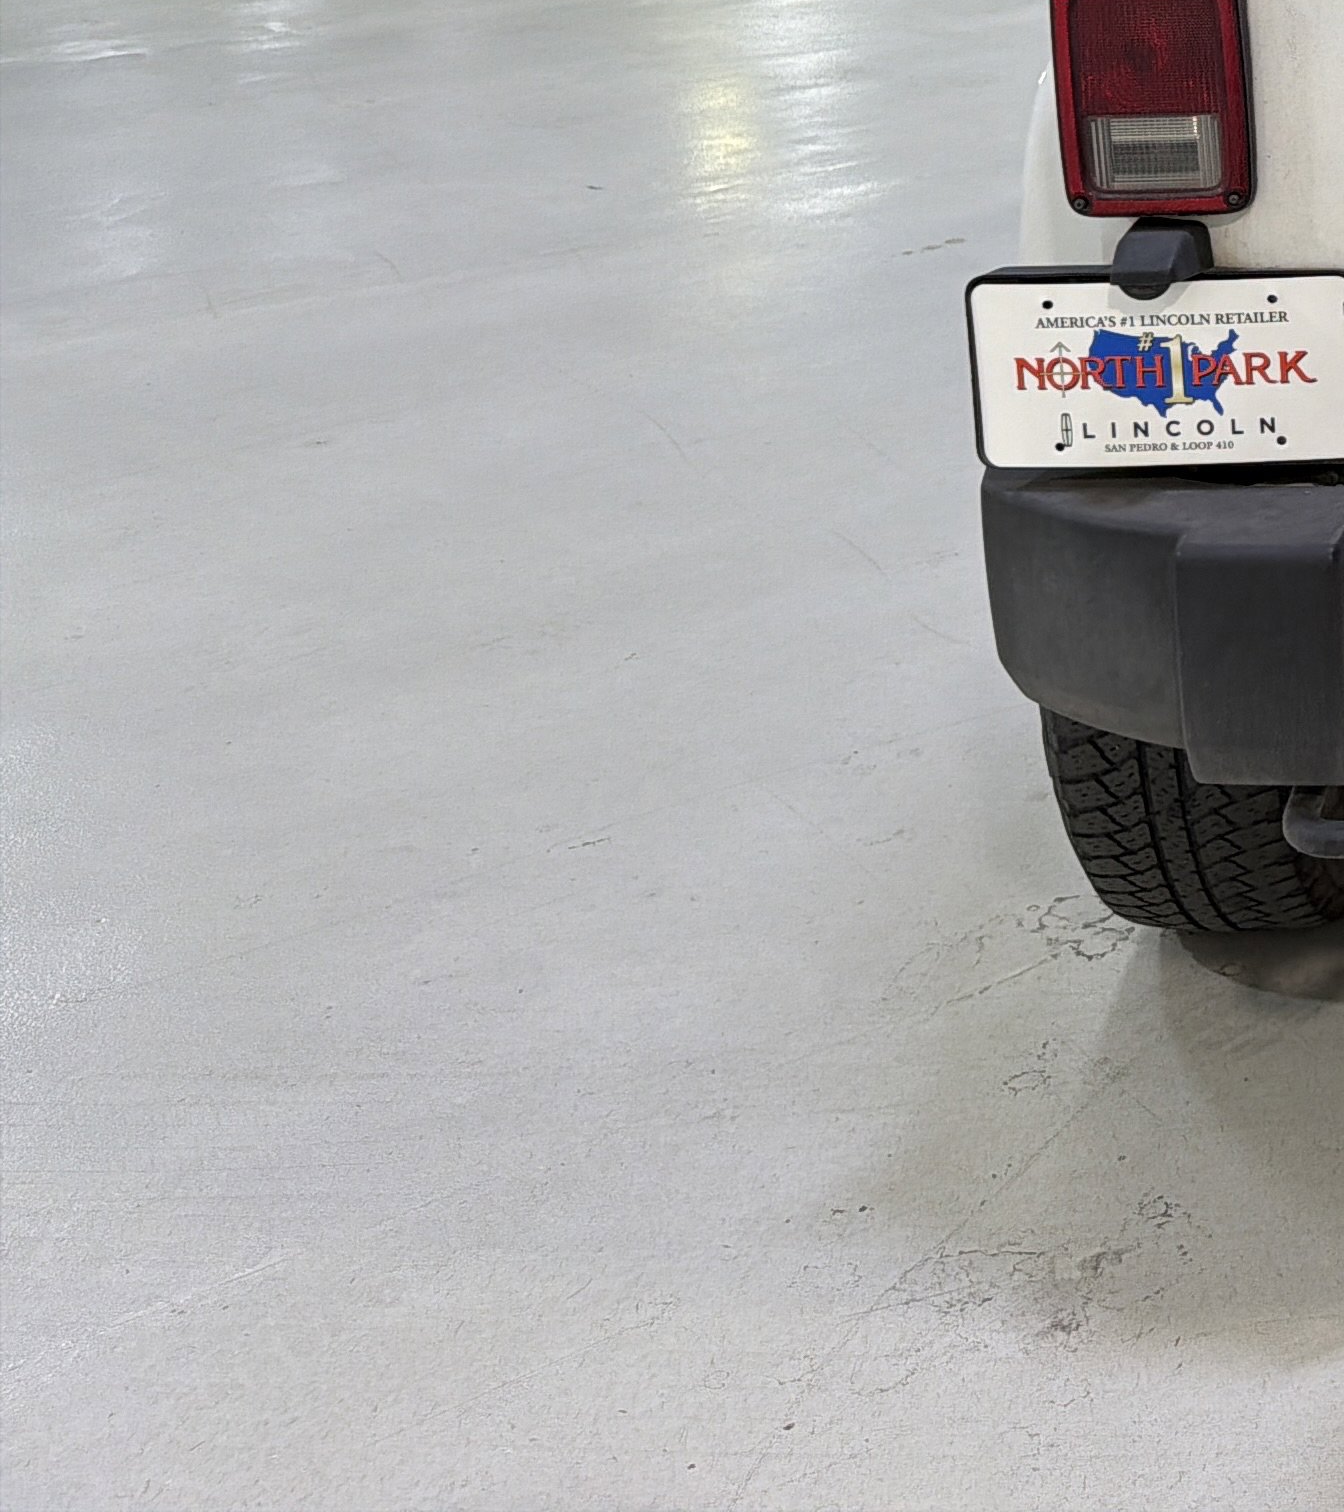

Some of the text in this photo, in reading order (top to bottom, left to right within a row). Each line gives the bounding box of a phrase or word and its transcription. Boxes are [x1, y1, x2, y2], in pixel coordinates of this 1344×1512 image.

[1034, 311, 1290, 329] AMERICA'S #1 LINCOLN RETAILER
[1013, 350, 1318, 391] NORTH PARK
[1082, 417, 1276, 439] LINCOLN
[1104, 440, 1235, 453] SAN PEDRO & LOOP 410
